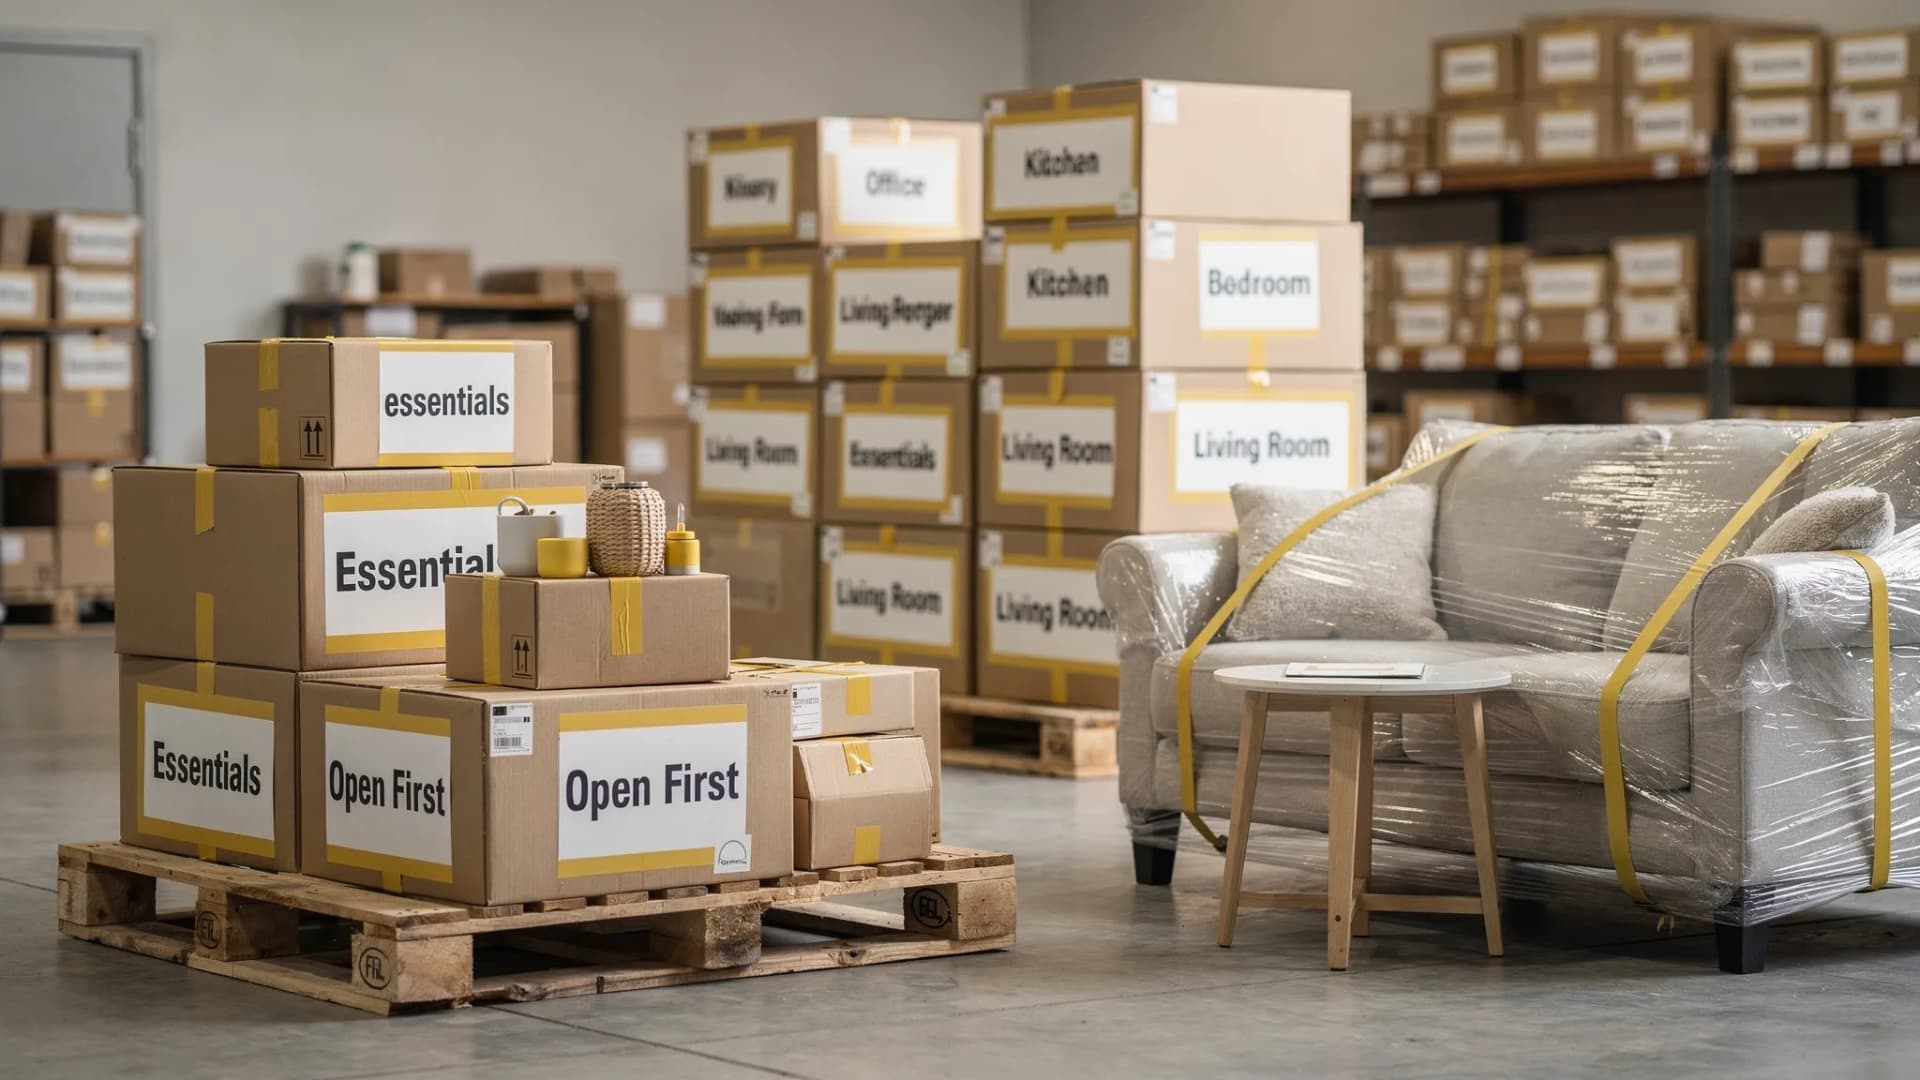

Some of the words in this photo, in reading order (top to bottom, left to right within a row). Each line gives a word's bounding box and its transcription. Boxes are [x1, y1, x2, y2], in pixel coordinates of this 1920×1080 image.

[865, 169, 926, 197] Office
[1026, 269, 1109, 298] Kitchen
[1207, 269, 1311, 296] Bedroom
[384, 384, 510, 417] essentials
[1002, 433, 1055, 469] Living
[1059, 435, 1113, 464] Room
[1194, 431, 1260, 464] Living
[1269, 433, 1329, 459] Room
[335, 544, 495, 592] Essential
[837, 581, 888, 614] Living
[891, 582, 942, 613] Room
[997, 595, 1051, 631] Living
[153, 741, 261, 796] Essentials
[329, 760, 385, 813] Open
[393, 768, 446, 816] First
[566, 769, 651, 821] Open
[665, 762, 739, 804] First
